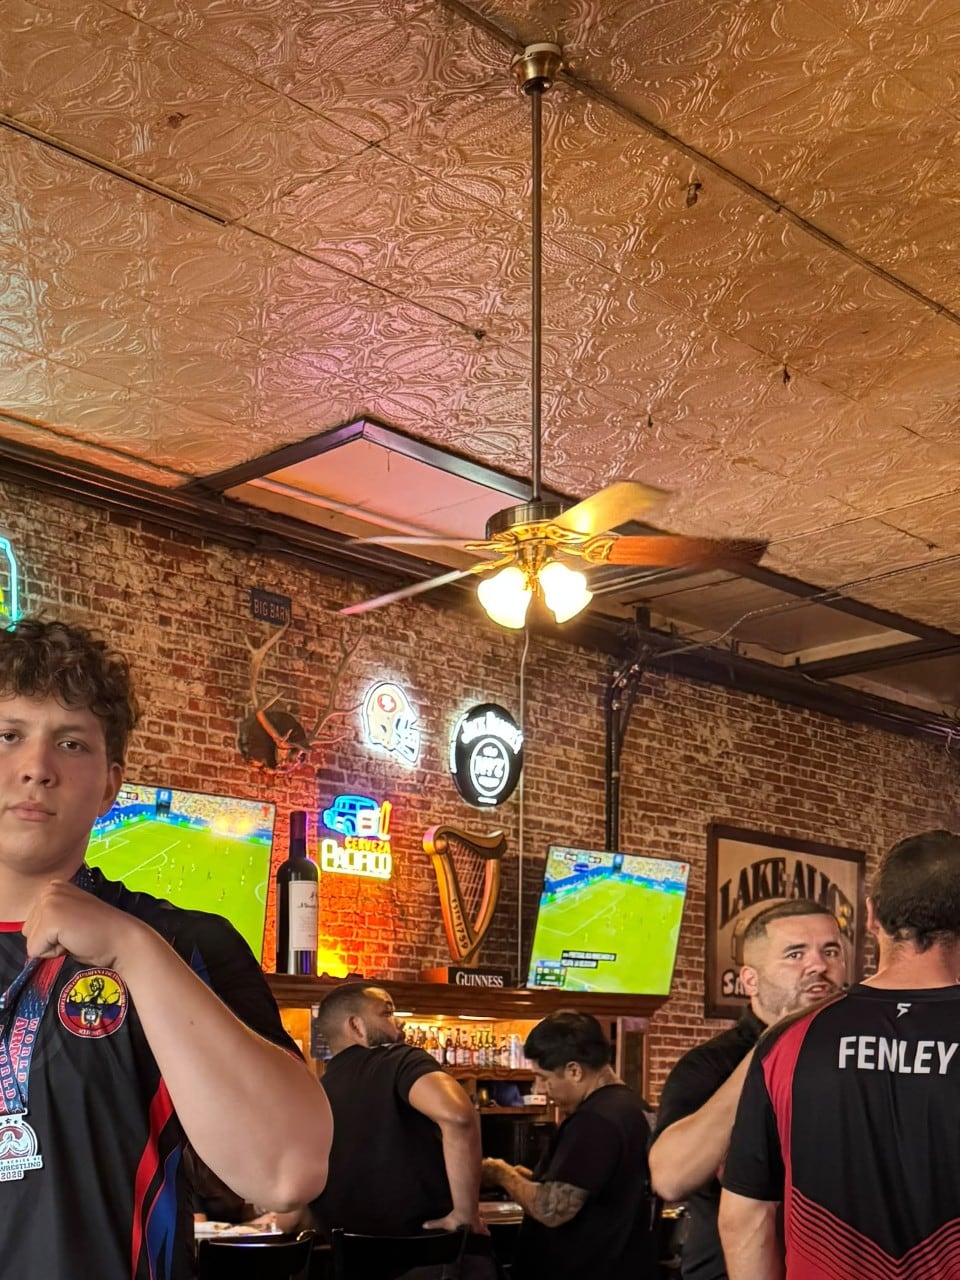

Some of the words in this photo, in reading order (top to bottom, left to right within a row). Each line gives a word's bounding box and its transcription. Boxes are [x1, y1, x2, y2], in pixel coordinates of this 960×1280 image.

[254, 599, 268, 616] BIG
[345, 837, 390, 854] CERVEZA
[720, 857, 786, 930] LAKE
[455, 971, 504, 988] GUINNESS
[838, 1035, 960, 1075] FENLEY
